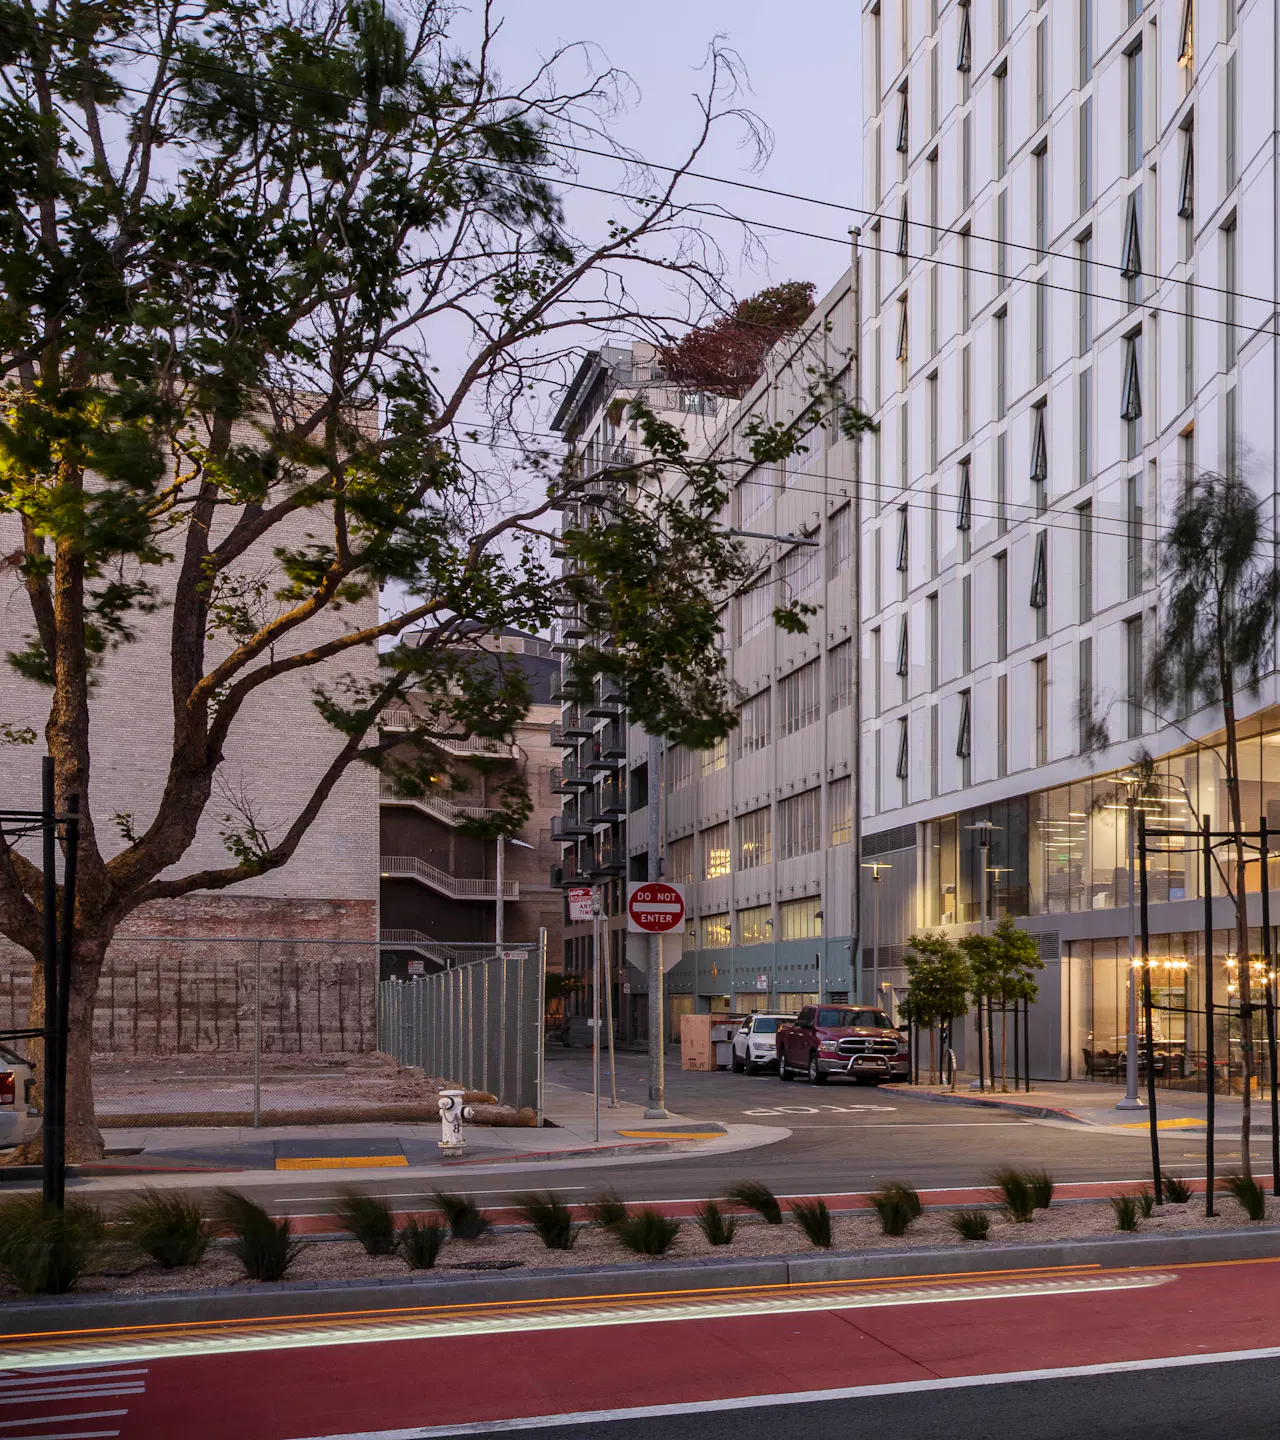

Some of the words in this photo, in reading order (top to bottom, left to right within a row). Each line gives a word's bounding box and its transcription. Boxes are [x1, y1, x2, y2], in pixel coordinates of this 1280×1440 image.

[637, 892, 651, 900] DO
[657, 892, 677, 901] NOT
[641, 914, 673, 922] ENTER
[452, 1123, 460, 1134] 8
